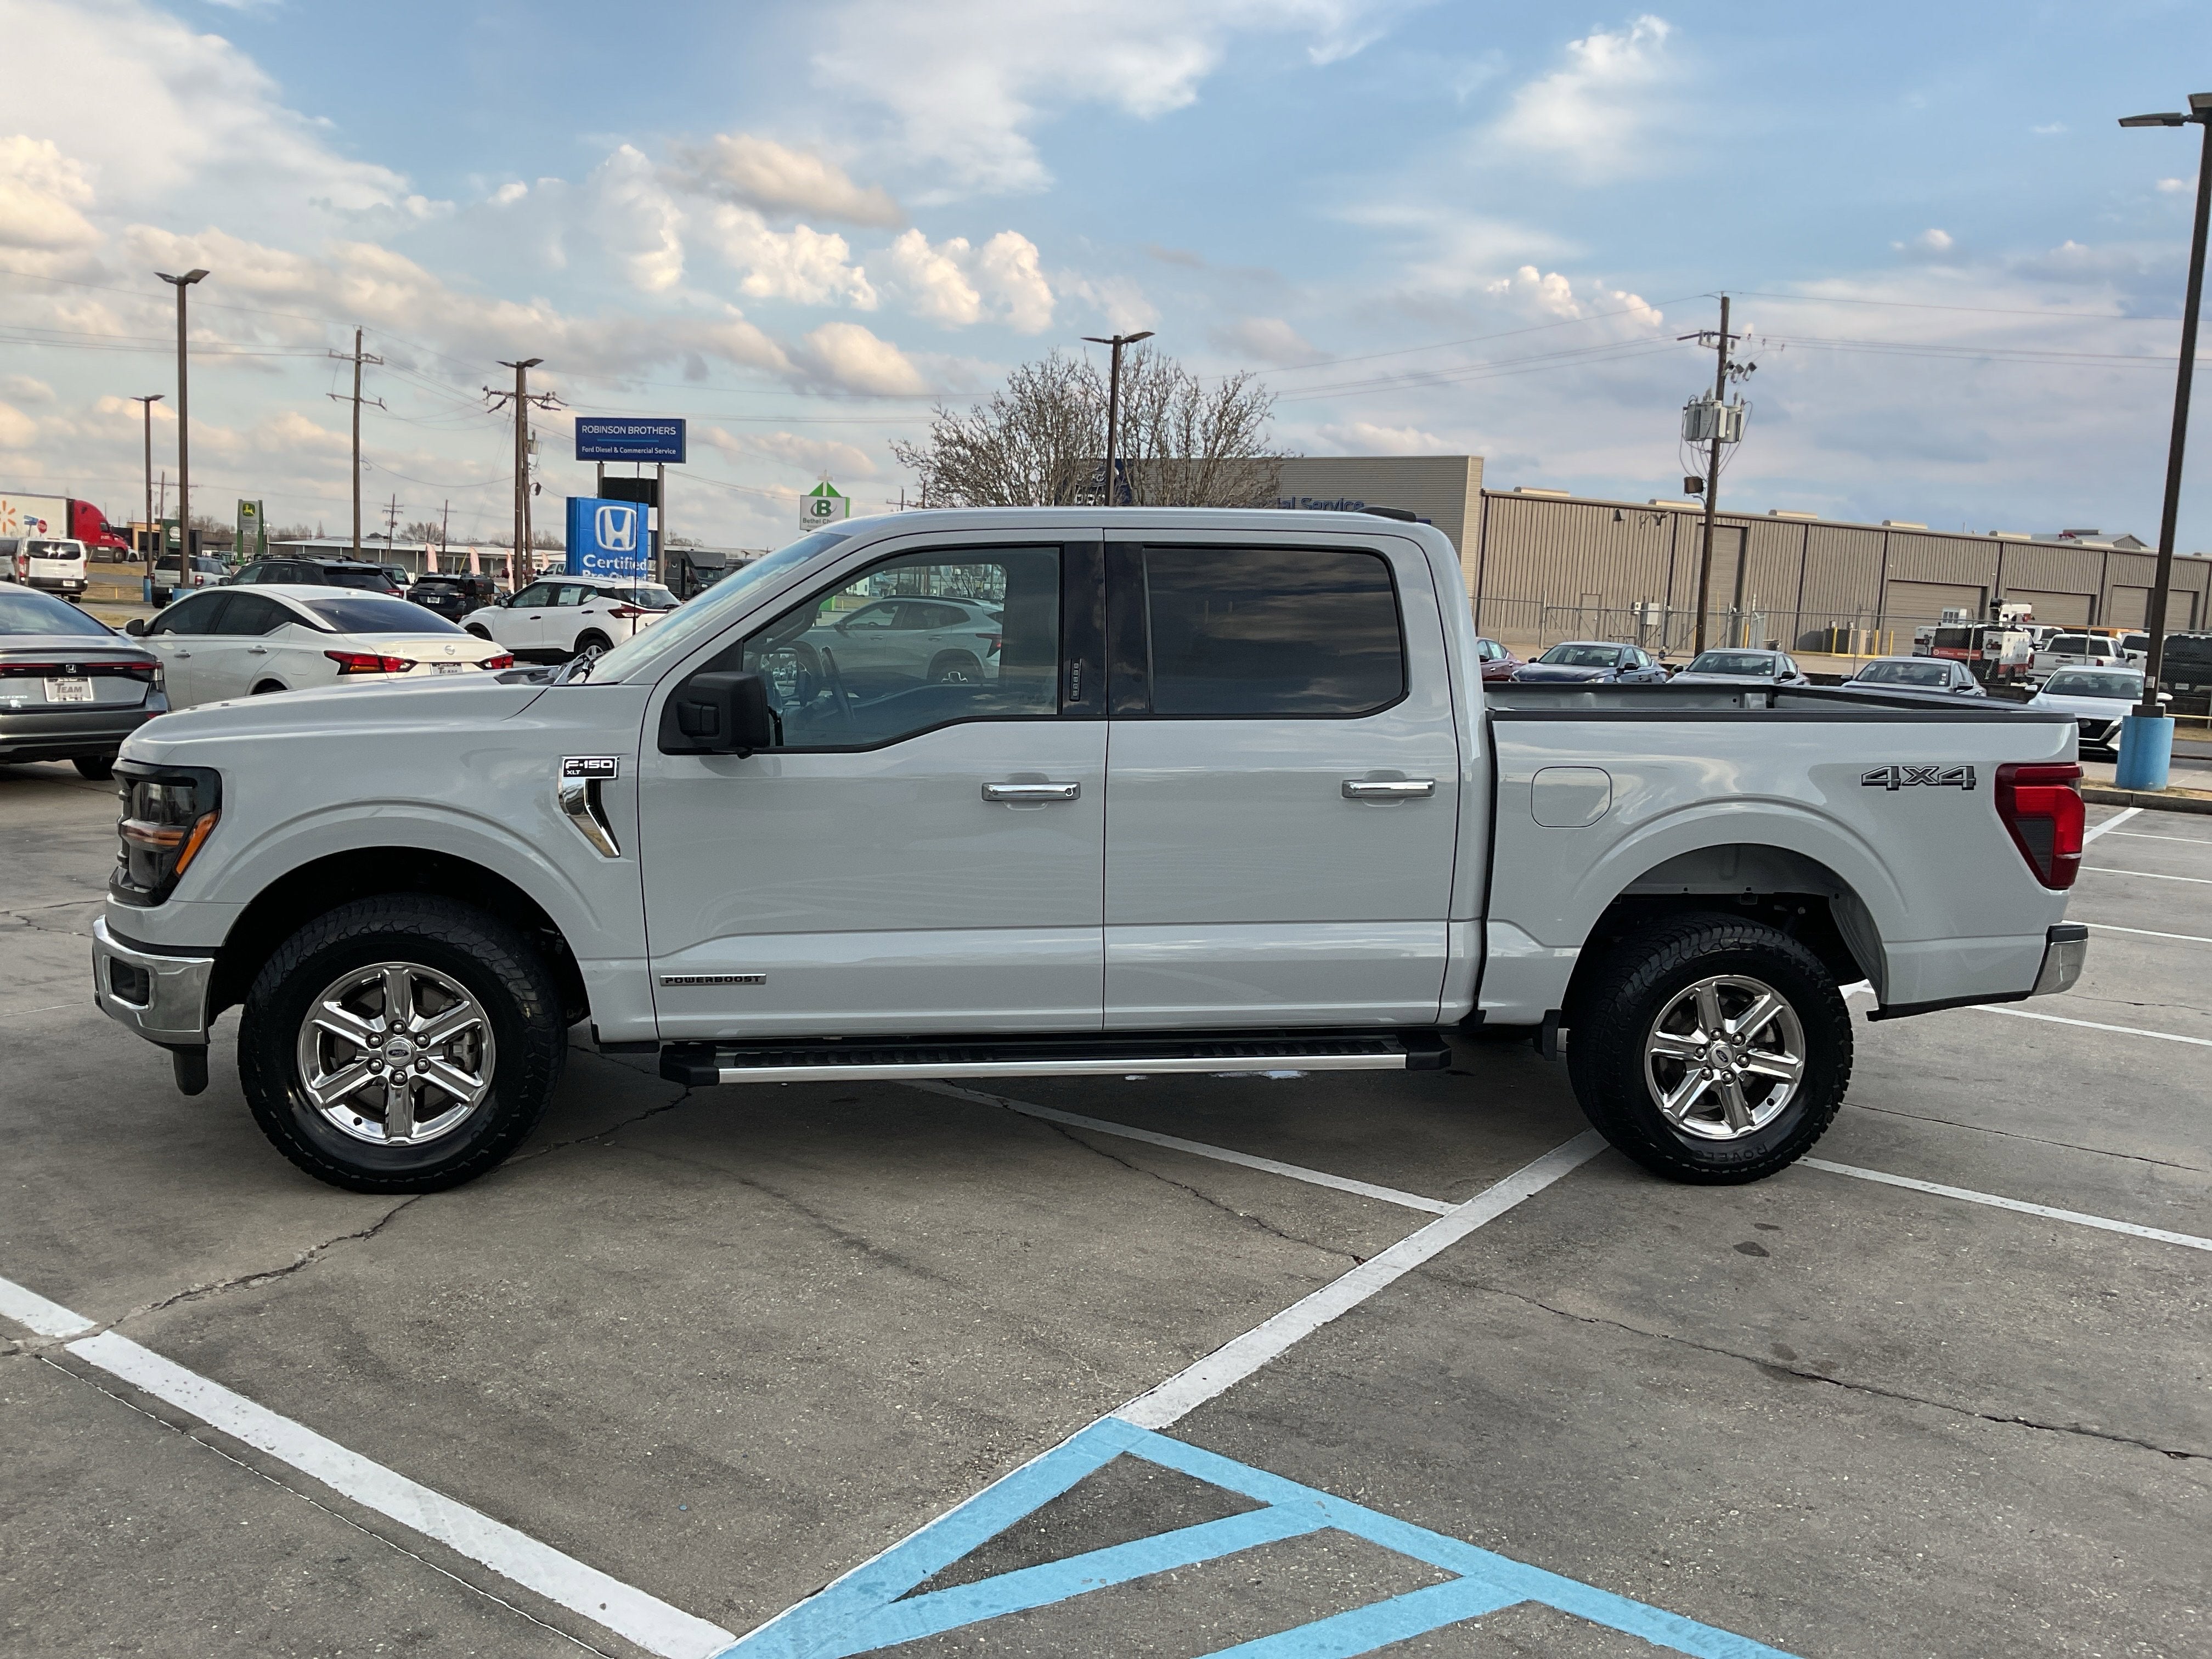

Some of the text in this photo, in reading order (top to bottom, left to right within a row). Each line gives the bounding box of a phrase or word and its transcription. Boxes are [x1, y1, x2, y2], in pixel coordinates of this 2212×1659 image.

[582, 425, 676, 435] ROBINSON BROTHERS
[583, 554, 647, 571] Certified
[565, 760, 613, 769] F-150
